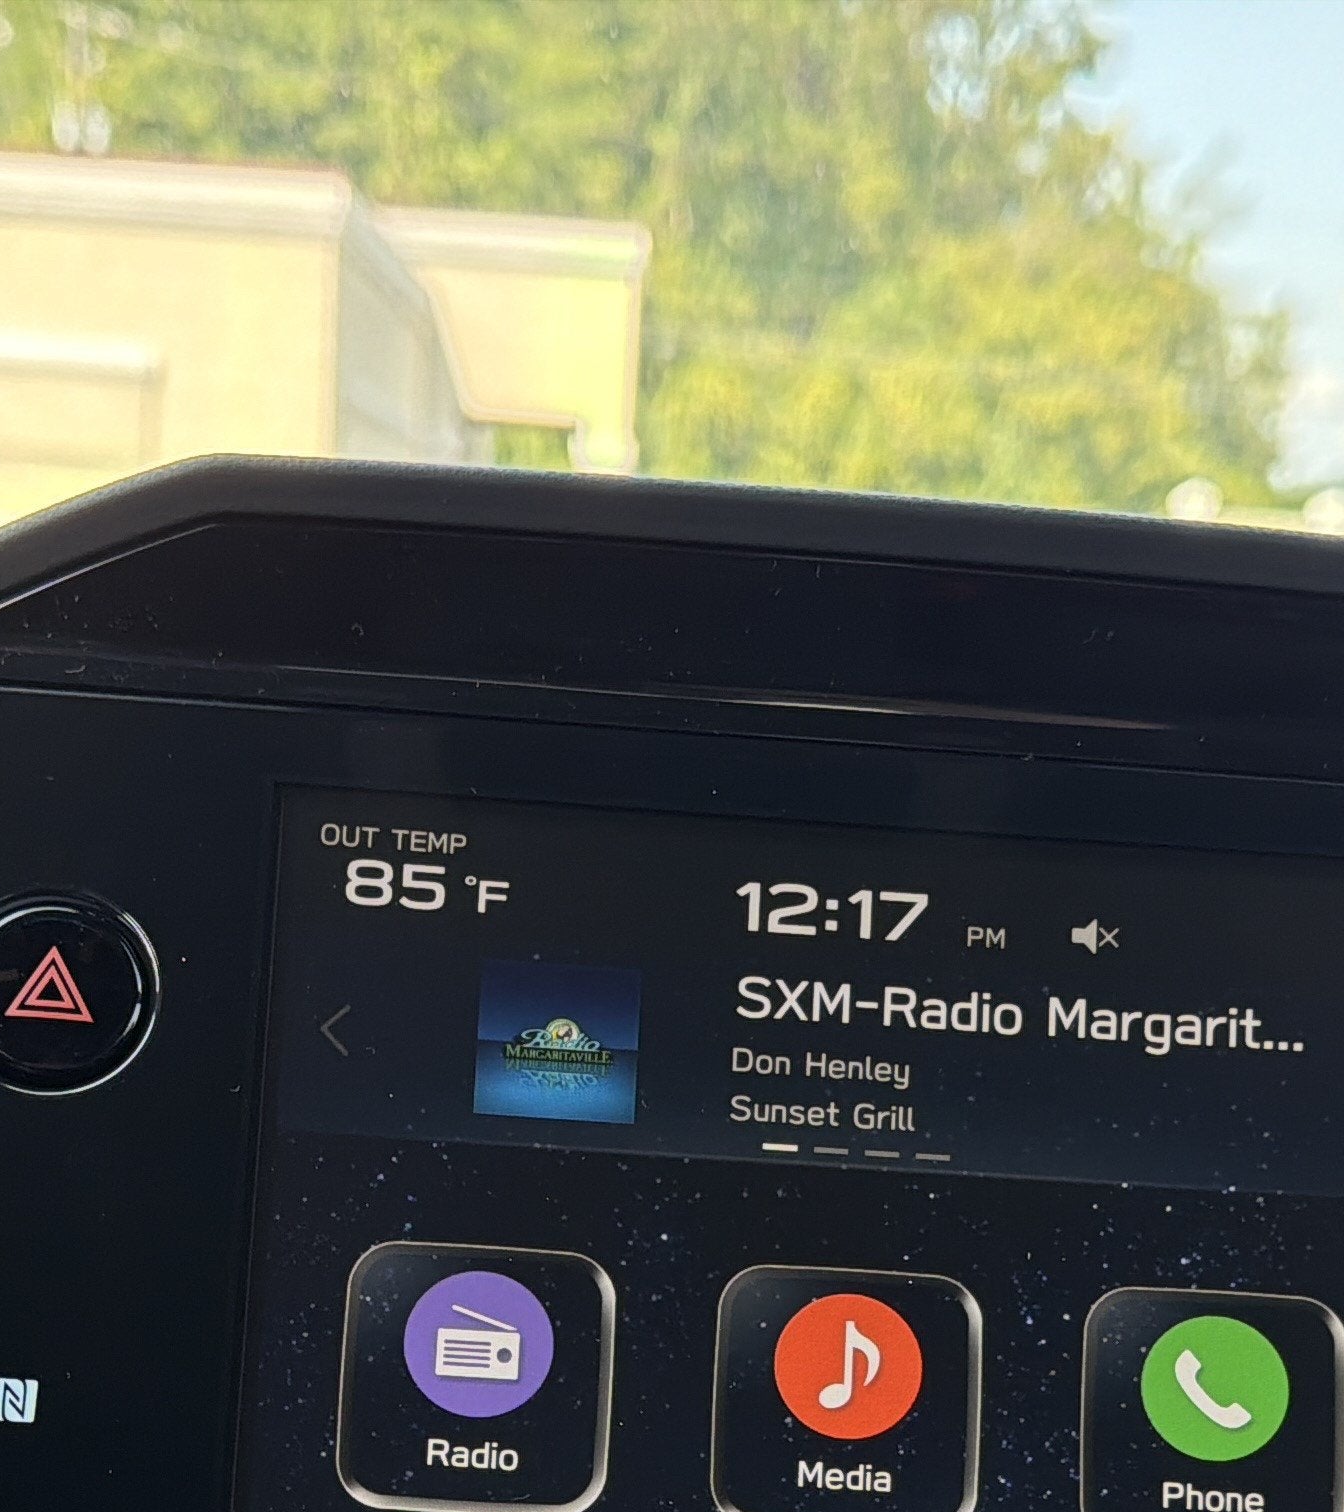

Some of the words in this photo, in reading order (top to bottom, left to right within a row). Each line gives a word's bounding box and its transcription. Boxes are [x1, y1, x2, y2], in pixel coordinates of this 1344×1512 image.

[319, 822, 381, 850] OUT
[390, 827, 468, 856] TEMP
[344, 858, 449, 912] 85
[735, 881, 931, 943] 12:17
[965, 925, 1007, 950] PM
[735, 974, 1024, 1037] SXM-Radio
[1047, 995, 1306, 1057] Margarit...
[731, 1046, 792, 1077] Don
[804, 1050, 911, 1091] Henley
[728, 1094, 841, 1128] Sunset
[852, 1102, 916, 1133] Grill
[425, 1437, 520, 1473] Radio
[796, 1459, 893, 1494] Media
